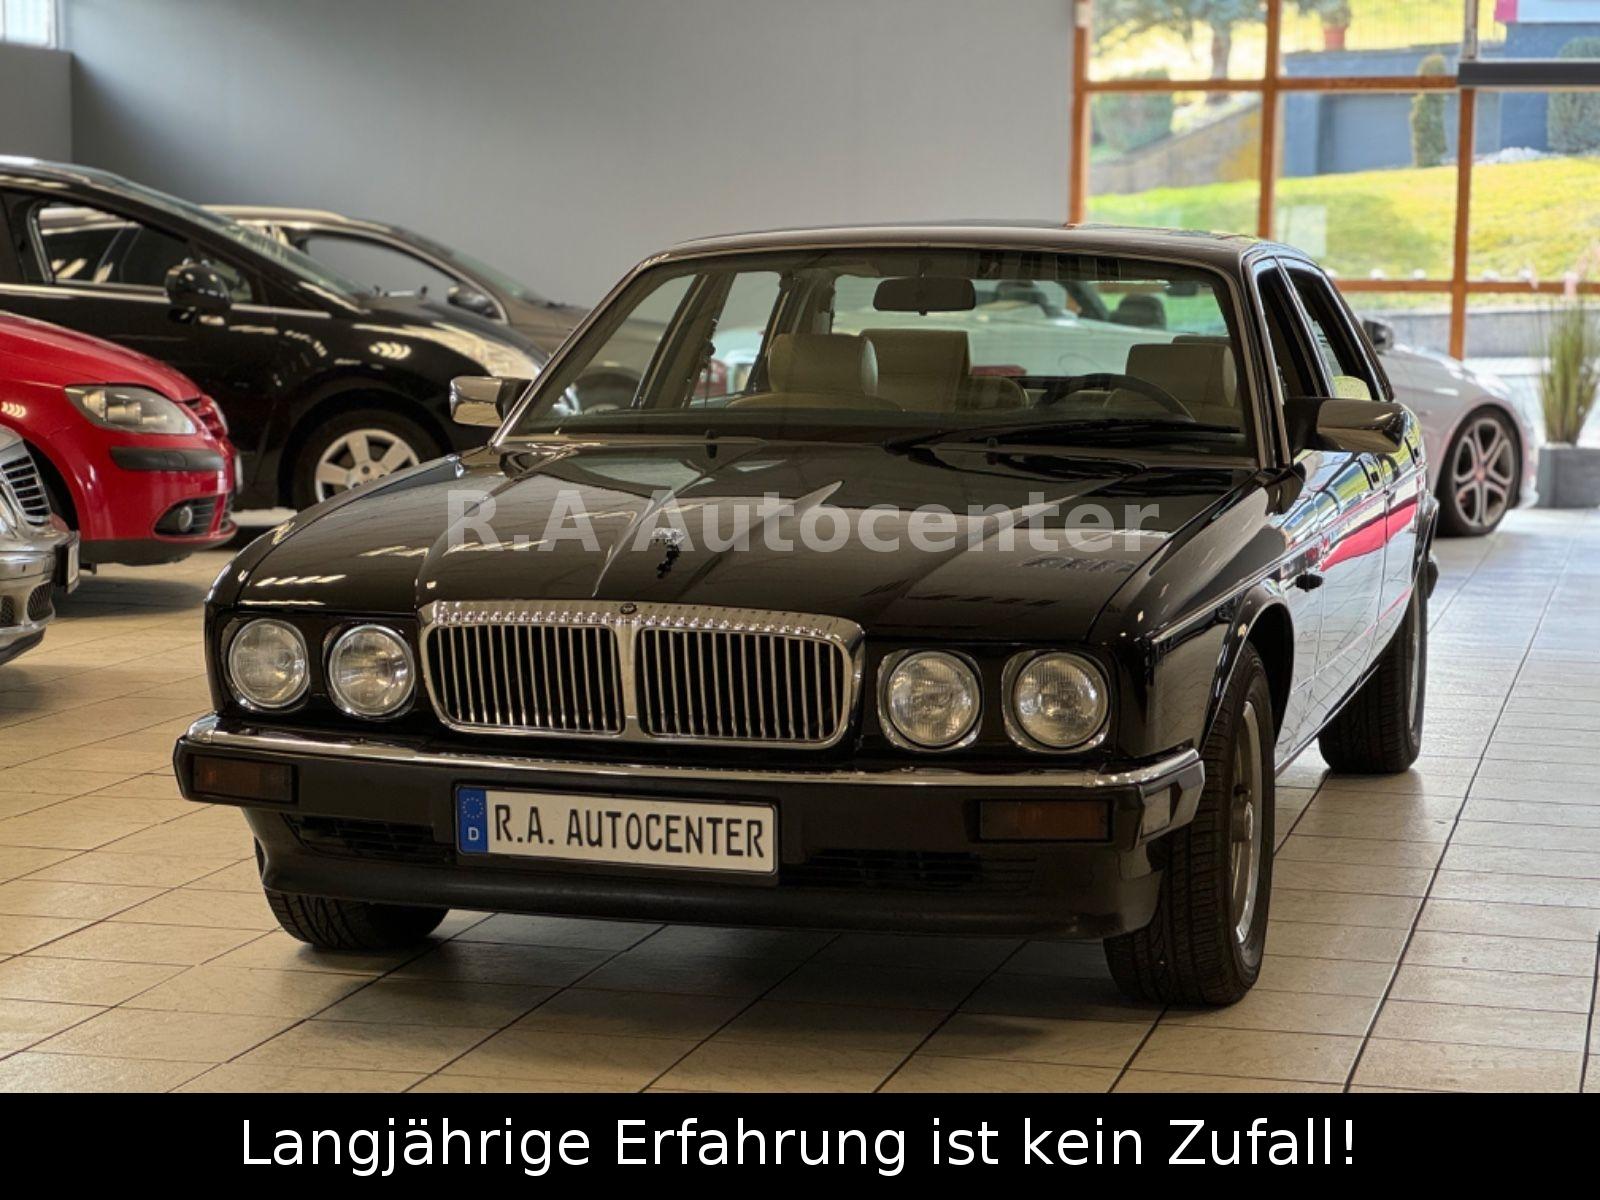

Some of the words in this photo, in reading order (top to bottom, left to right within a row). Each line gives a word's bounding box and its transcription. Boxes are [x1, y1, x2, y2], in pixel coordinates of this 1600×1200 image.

[467, 826, 479, 841] D
[494, 803, 554, 845] R.A.
[566, 808, 764, 858] AUTOCENTER
